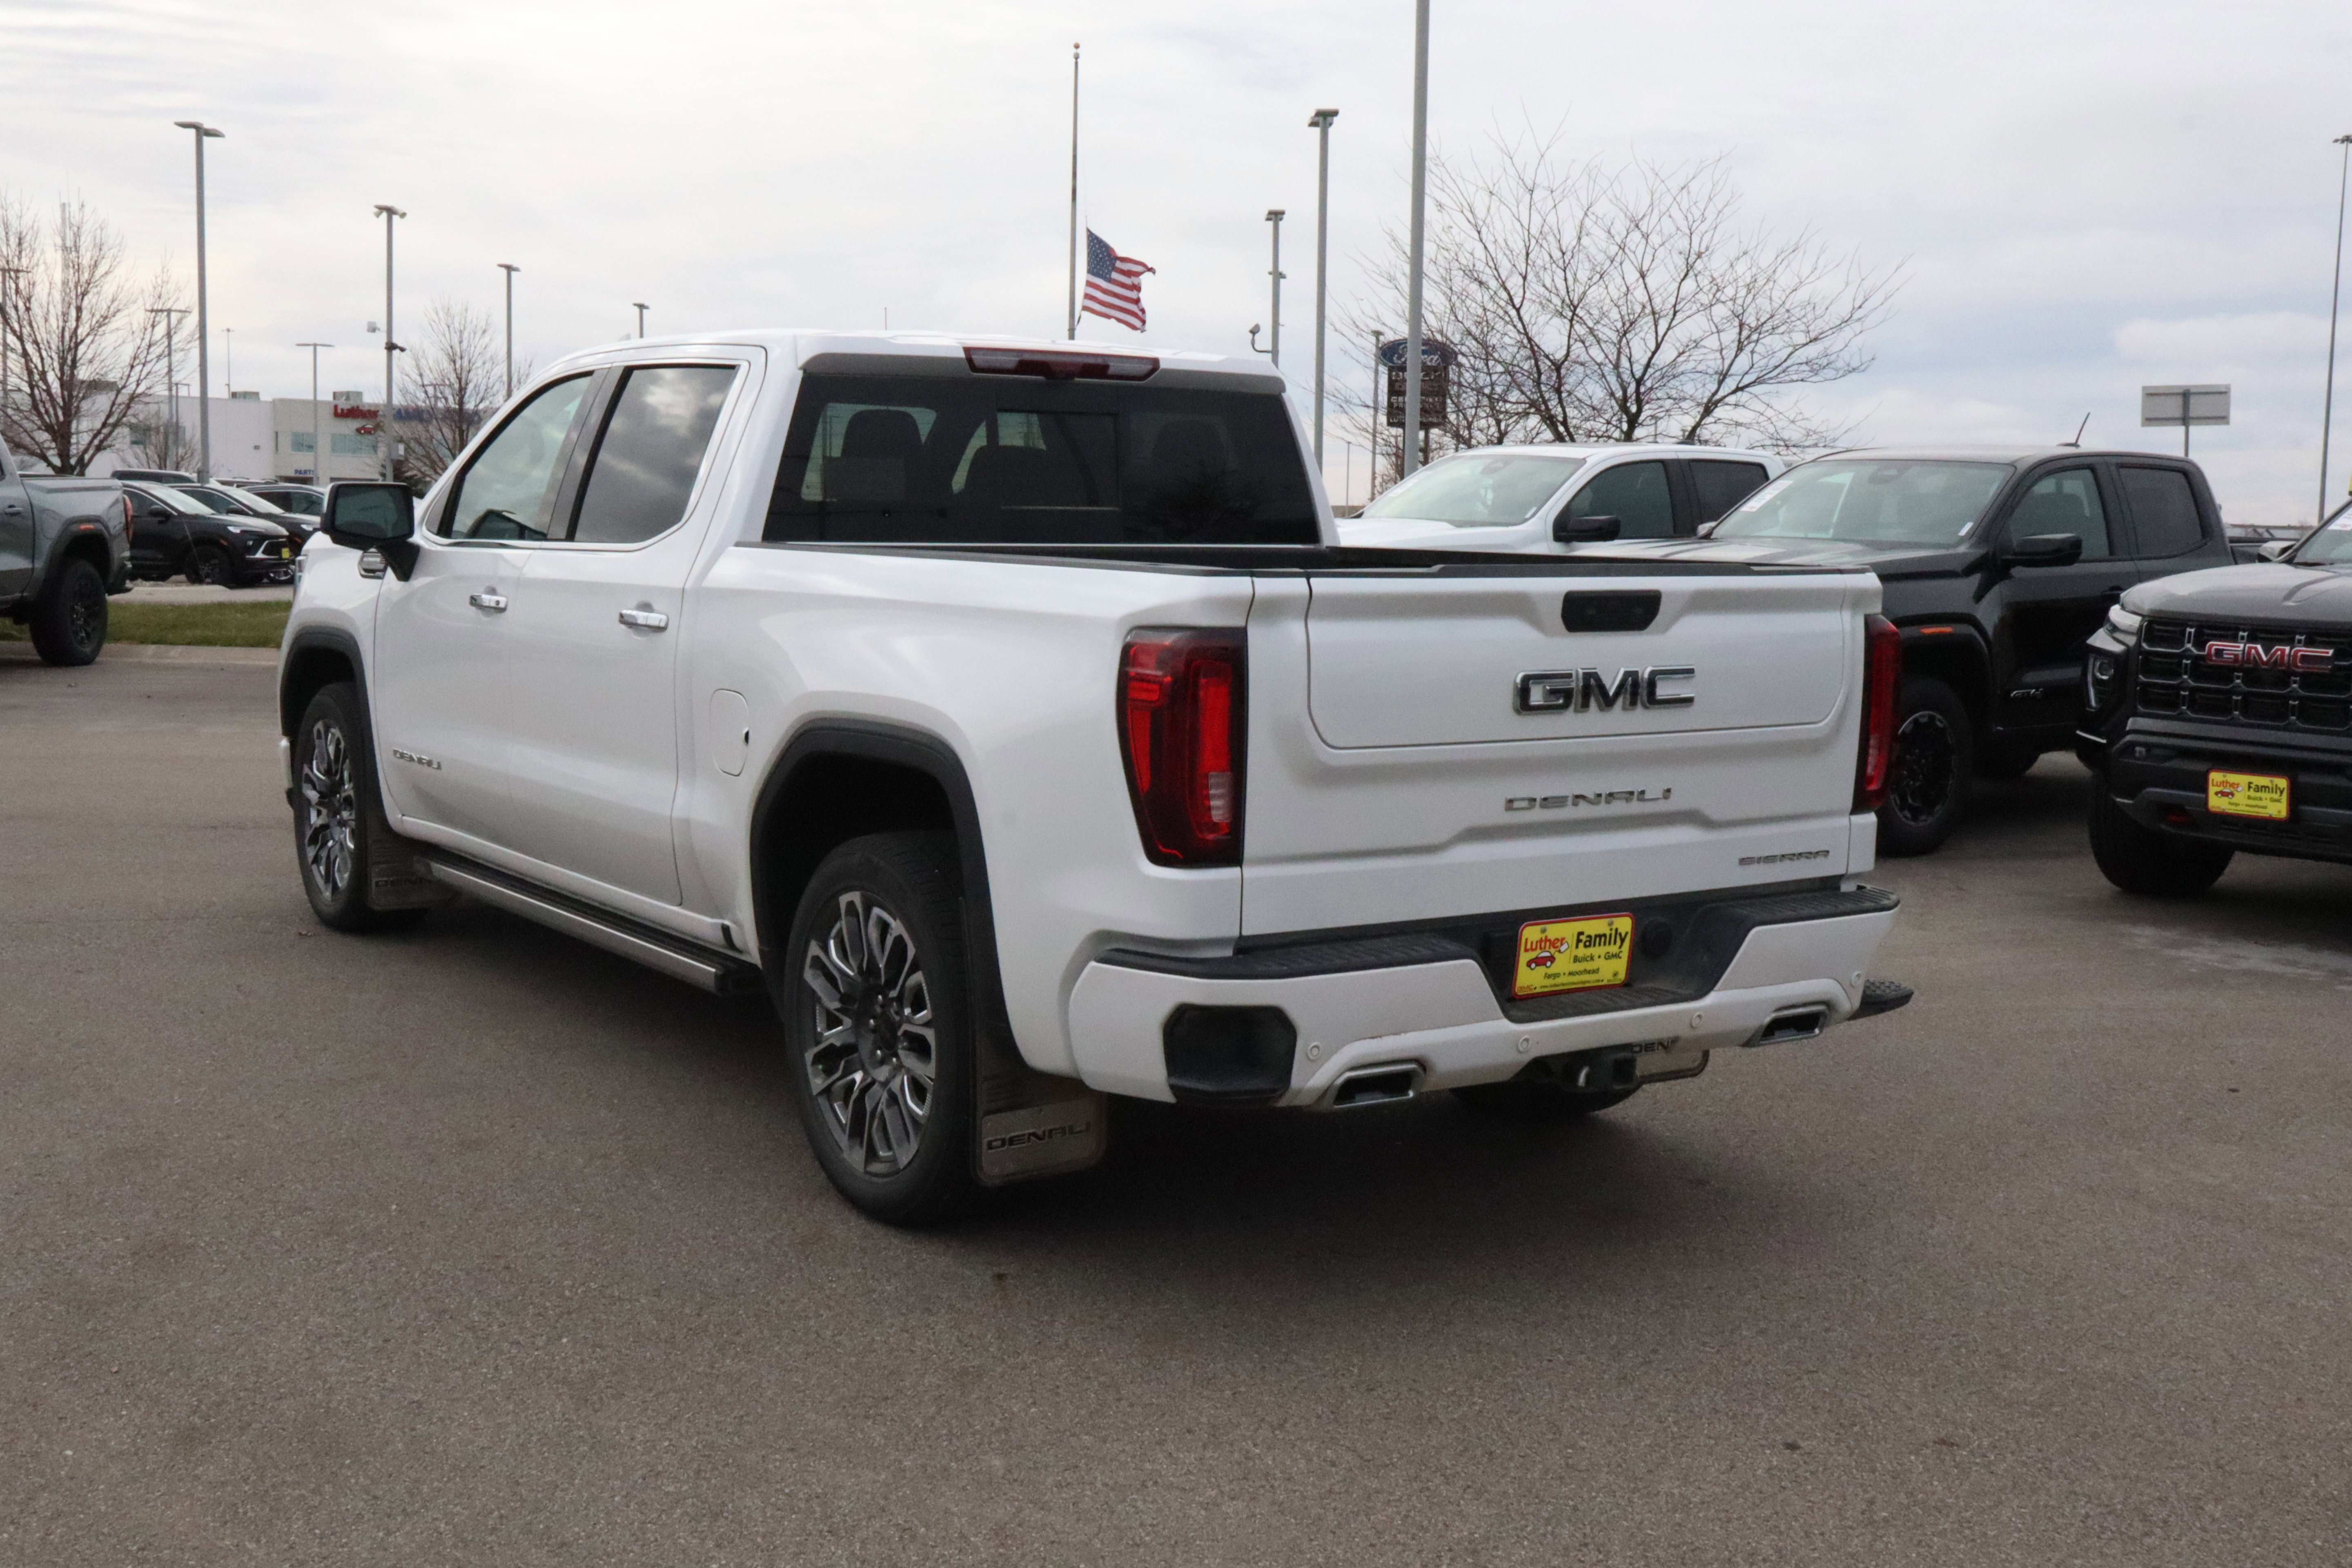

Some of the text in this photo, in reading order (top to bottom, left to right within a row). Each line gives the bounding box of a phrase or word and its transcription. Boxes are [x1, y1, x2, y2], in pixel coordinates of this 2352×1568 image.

[334, 404, 380, 419] Luther
[2205, 641, 2334, 673] GMC
[1513, 664, 1695, 715] GMC
[393, 748, 442, 770] DENALI
[2212, 778, 2285, 797] Luther Family
[1505, 786, 1672, 812] DENALI
[1738, 850, 1830, 866] SIERRA
[1523, 927, 1629, 953] Luther Family
[1573, 951, 1623, 964] Buick GMC
[1568, 967, 1600, 976] Moorhead
[987, 1122, 1091, 1151] DENALI
